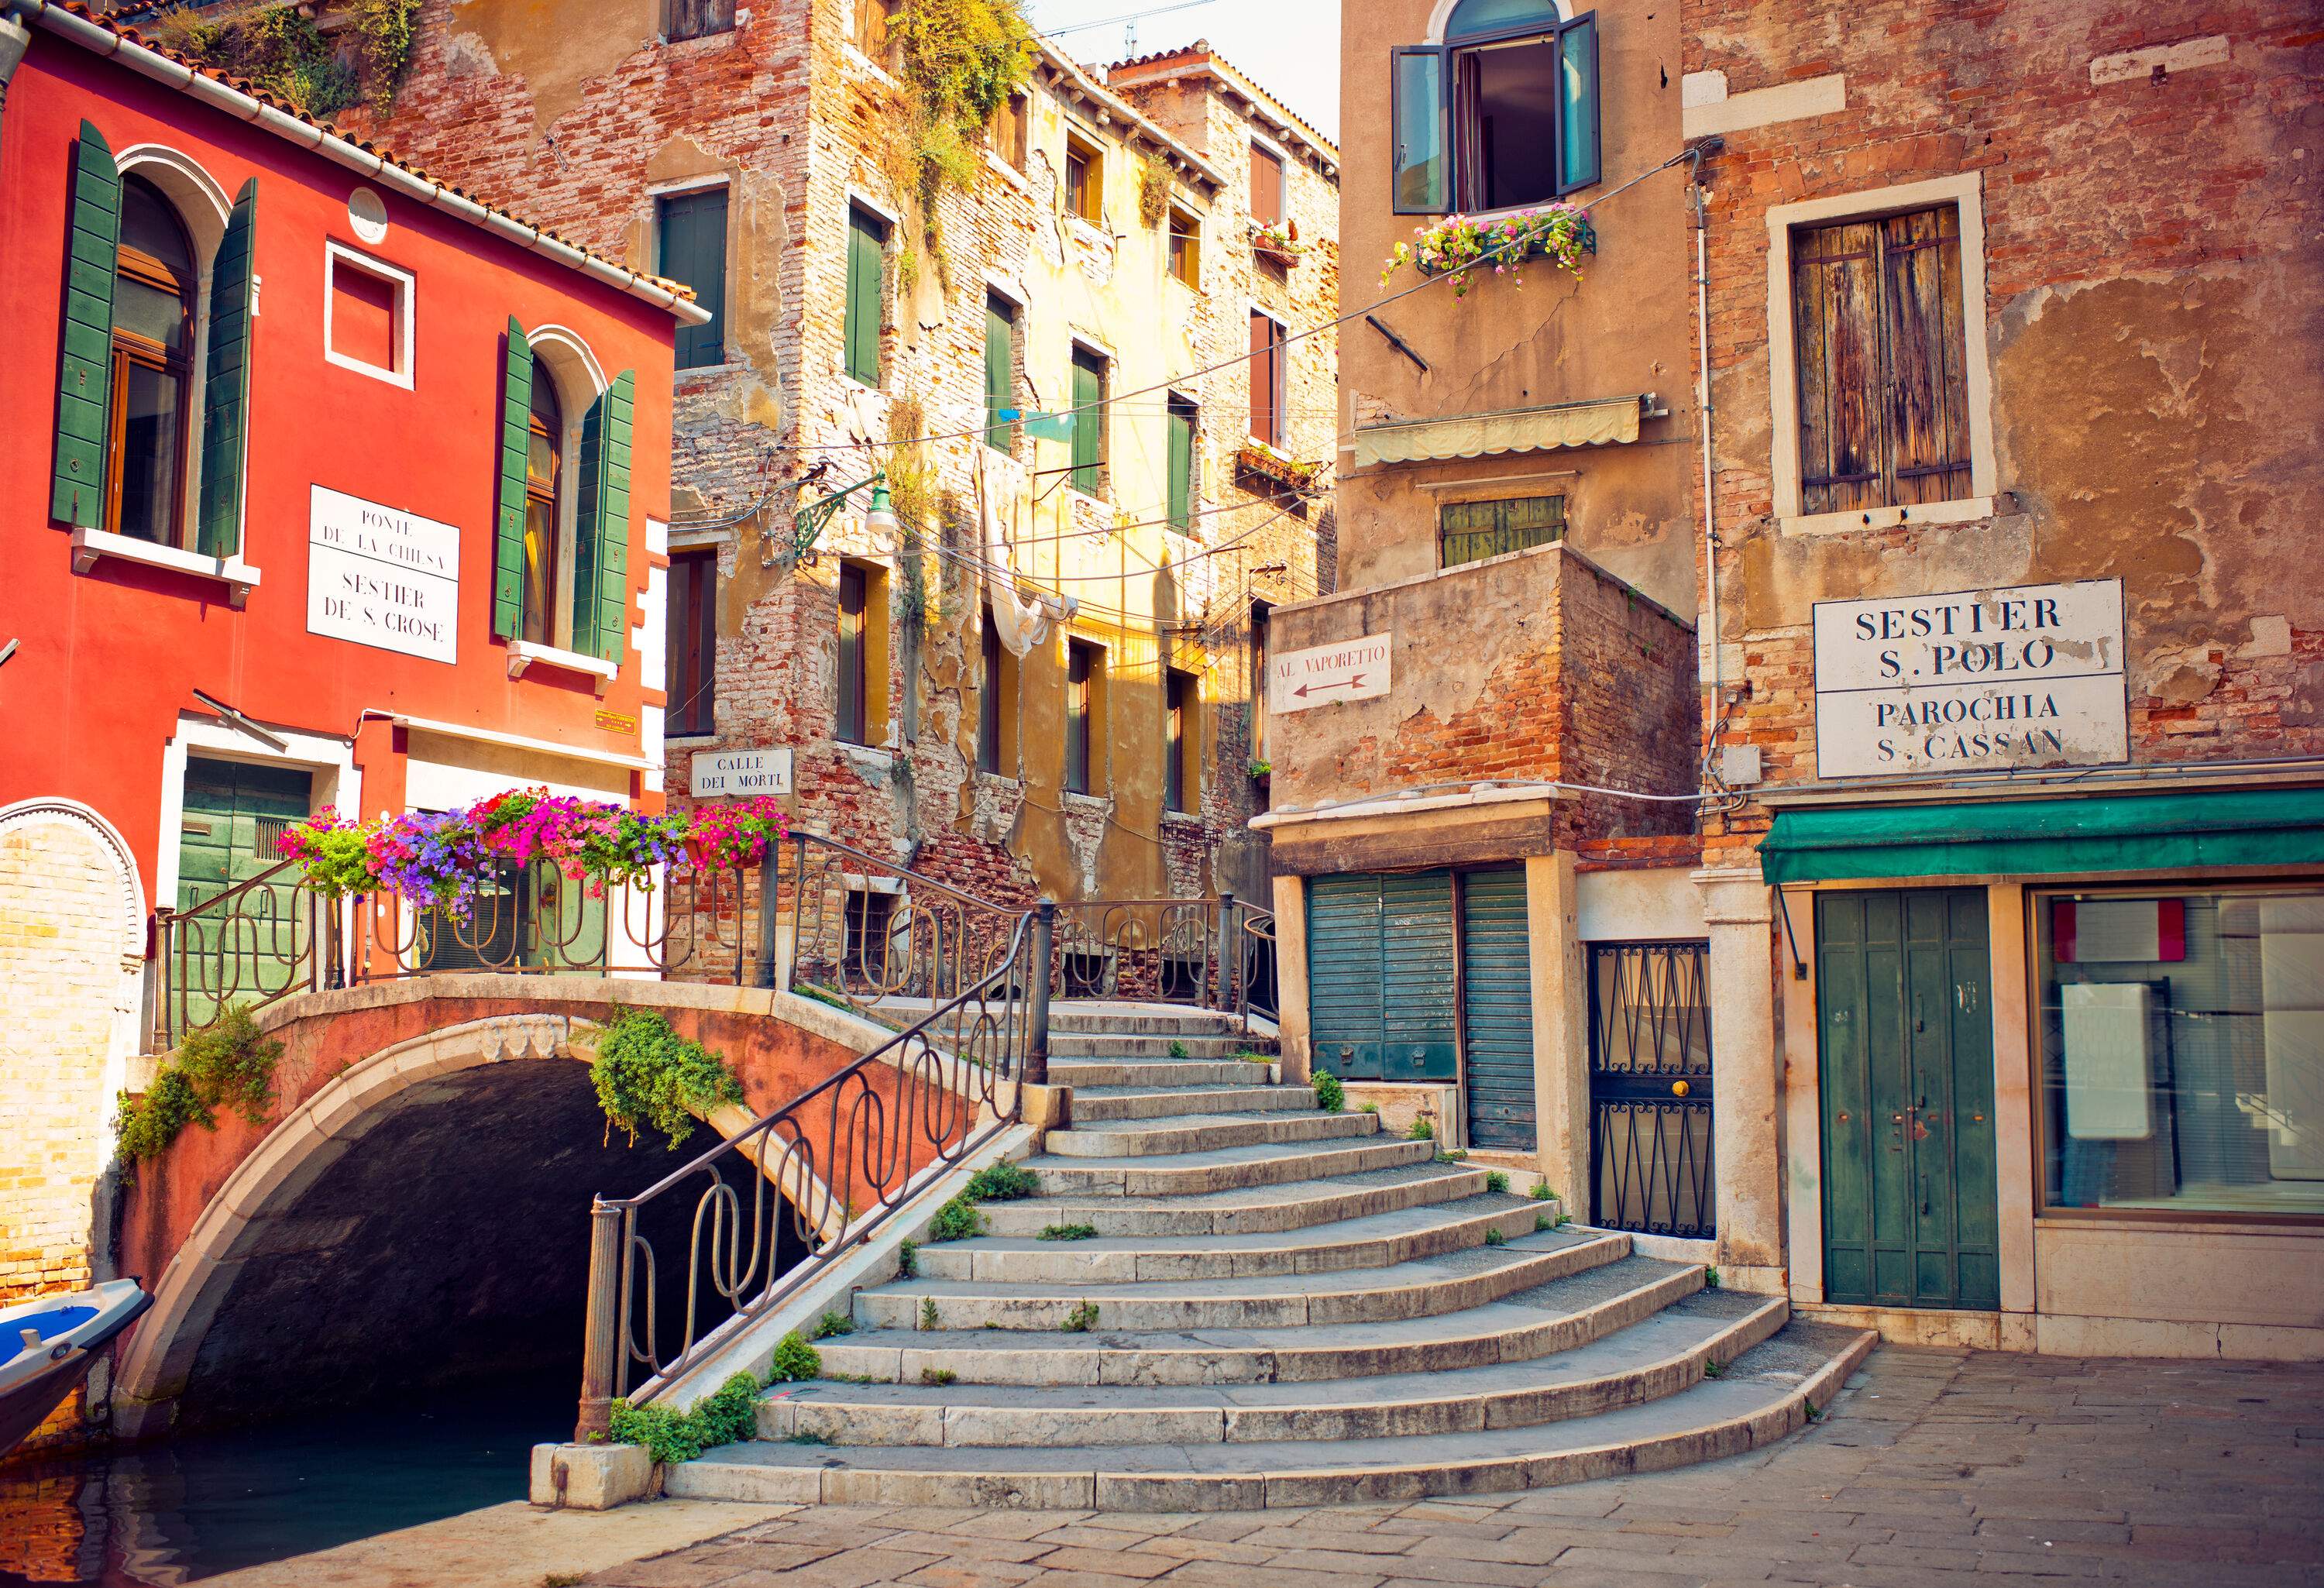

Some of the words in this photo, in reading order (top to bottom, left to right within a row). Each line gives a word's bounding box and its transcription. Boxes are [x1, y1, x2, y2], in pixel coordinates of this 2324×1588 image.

[324, 524, 345, 544] DE
[359, 534, 377, 552] LA
[389, 542, 444, 569] CHIESA
[342, 572, 425, 609] SESTIER
[325, 596, 352, 620] DE
[385, 611, 444, 643] CROSE
[1856, 598, 2061, 641] SESTIER
[1277, 662, 1295, 679] AL
[1305, 645, 1385, 673] VAPORETTO
[1876, 693, 2060, 727] PAROCHIA
[717, 756, 765, 771] CALLE
[701, 776, 726, 789] DEI
